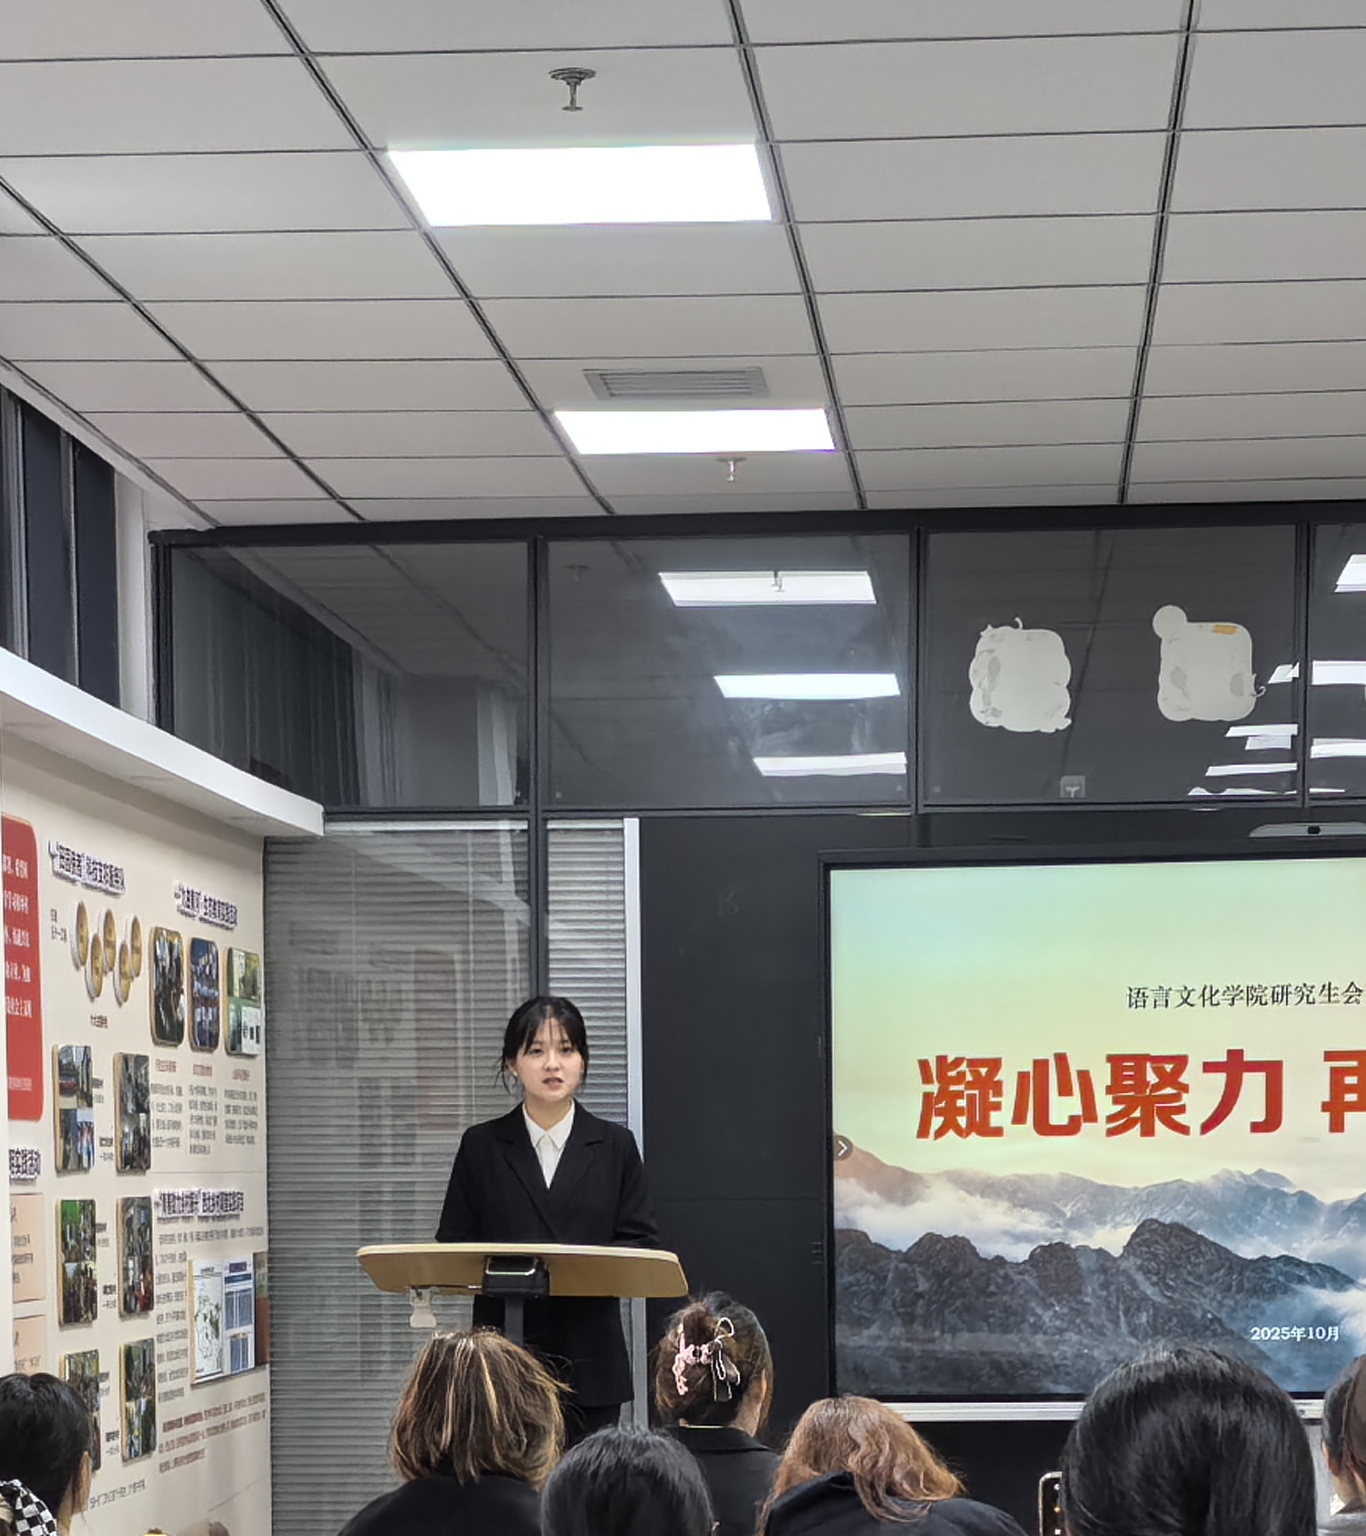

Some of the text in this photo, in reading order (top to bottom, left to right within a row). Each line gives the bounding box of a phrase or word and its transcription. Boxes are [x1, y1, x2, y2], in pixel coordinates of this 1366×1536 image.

[916, 1049, 1284, 1140] 凝心聚力
[1249, 1324, 1342, 1344] 2025年10月
